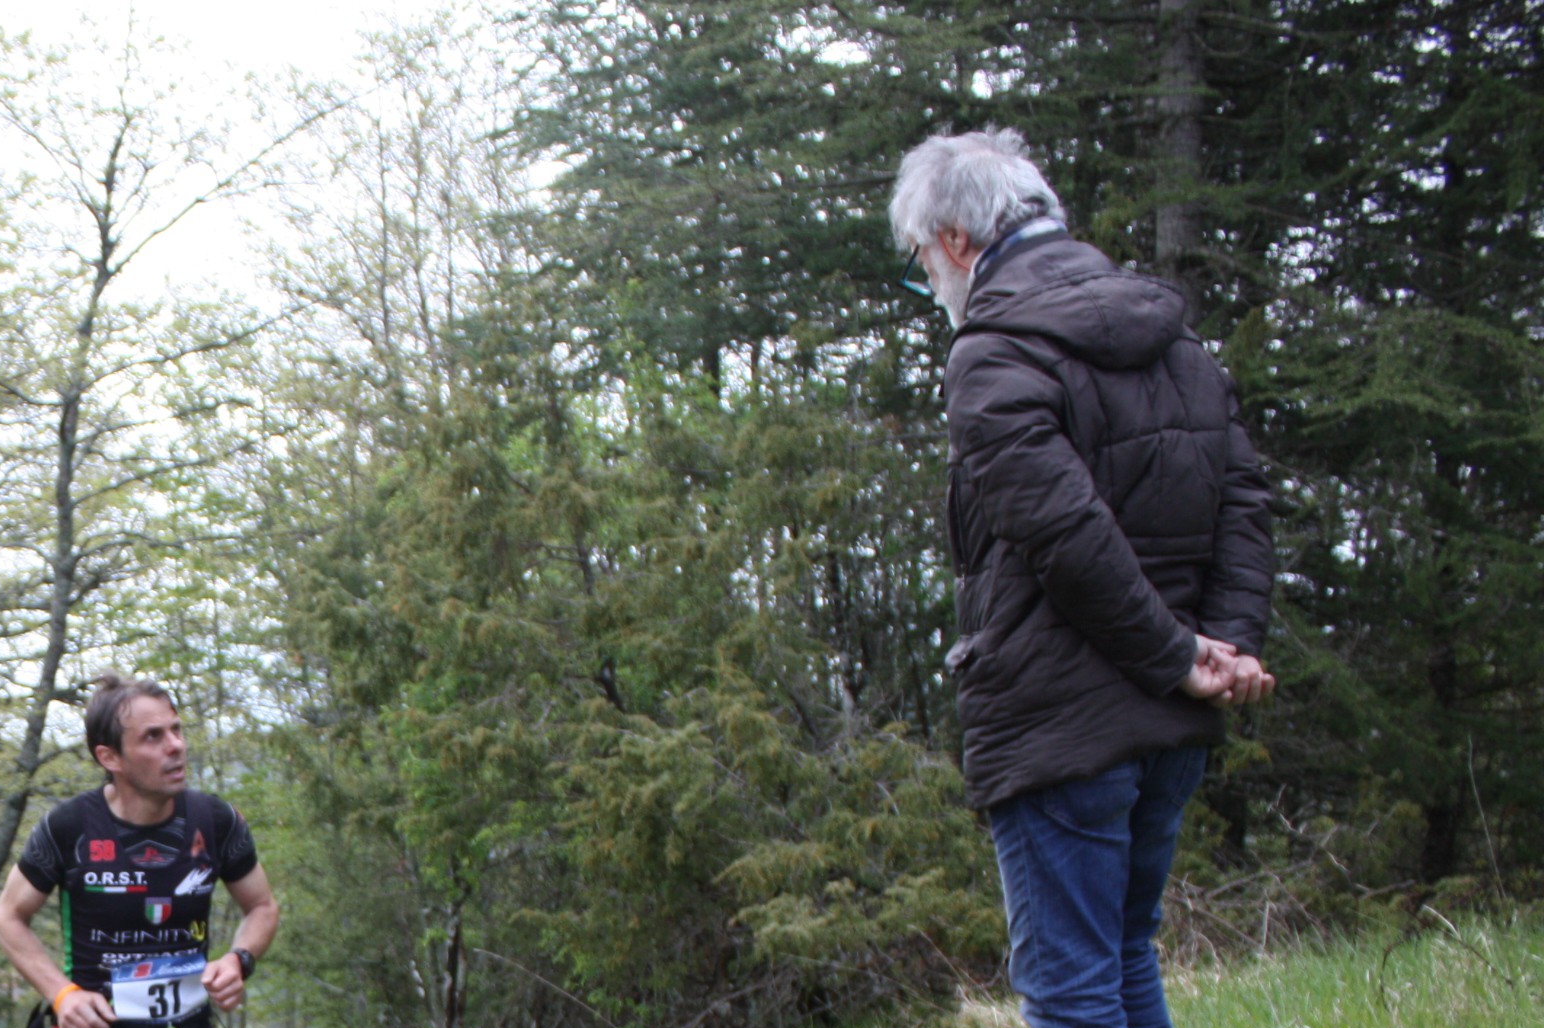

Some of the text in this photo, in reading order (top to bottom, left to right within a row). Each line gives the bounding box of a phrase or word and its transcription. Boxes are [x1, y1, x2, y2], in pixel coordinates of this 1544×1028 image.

[84, 871, 148, 885] O.R.S.T.
[91, 928, 194, 943] INFINITY
[148, 979, 183, 1019] 31
